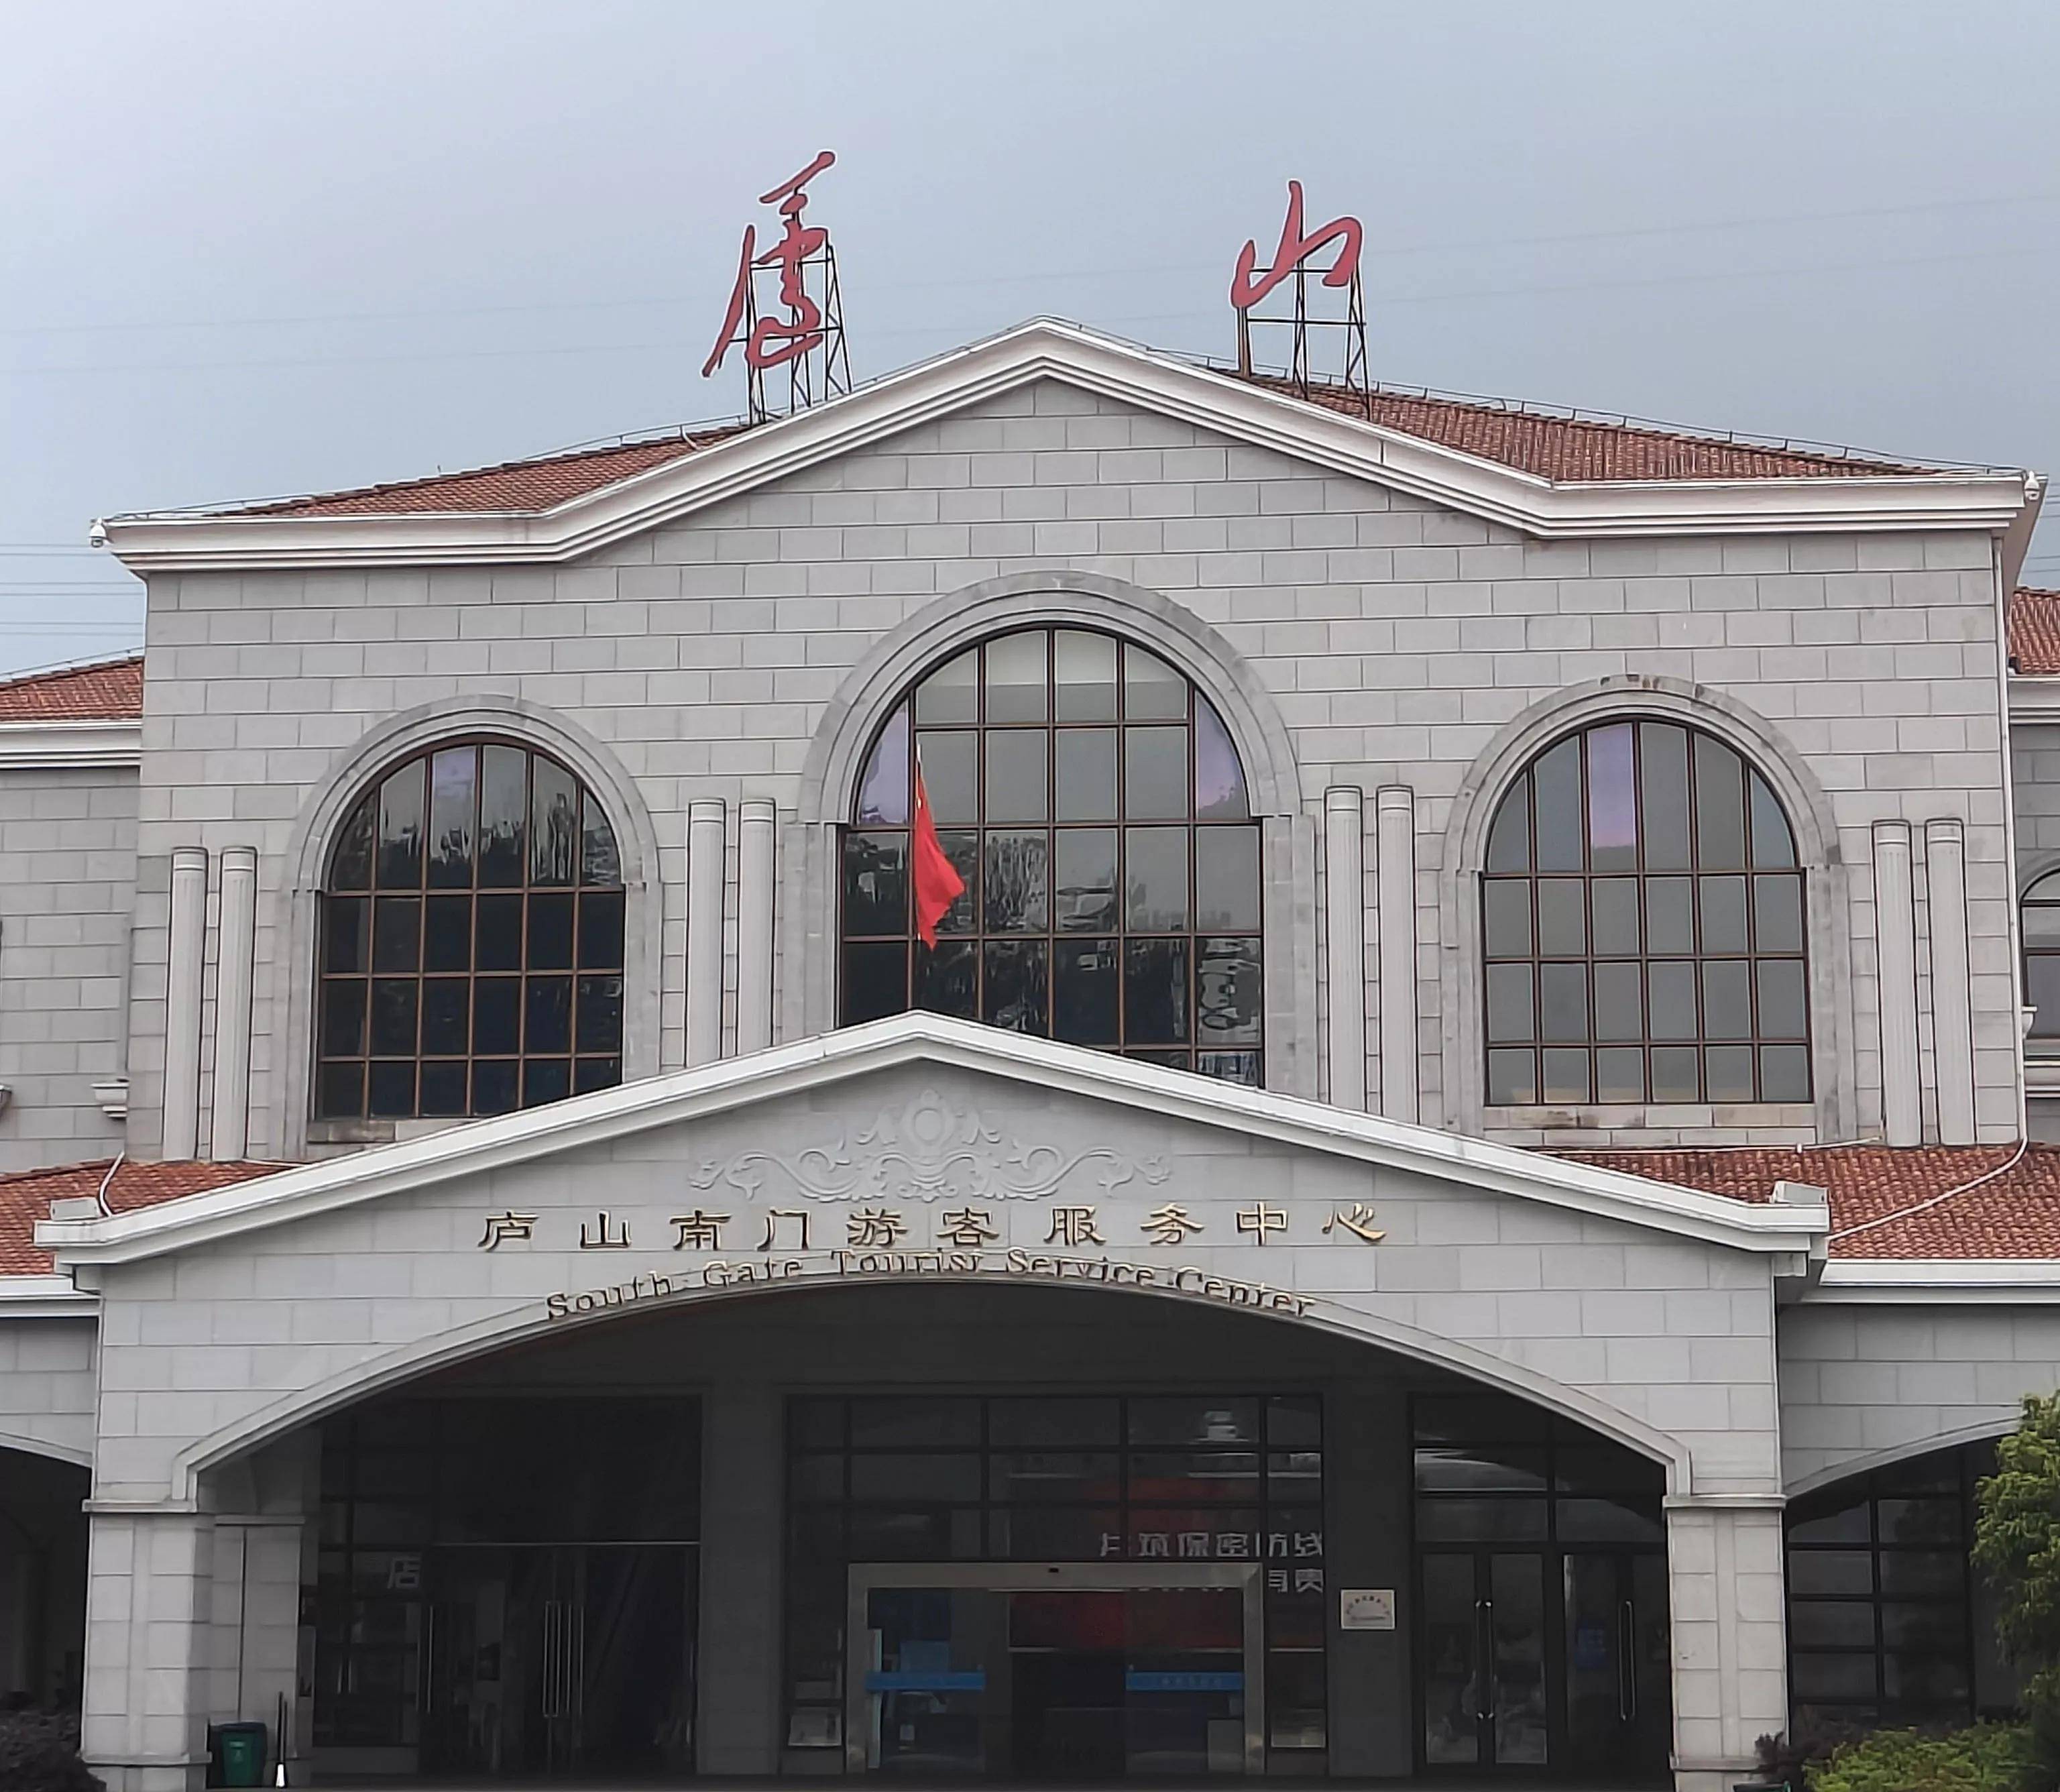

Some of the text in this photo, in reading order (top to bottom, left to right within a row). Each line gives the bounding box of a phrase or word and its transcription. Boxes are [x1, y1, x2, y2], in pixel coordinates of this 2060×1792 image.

[477, 1202, 1387, 1251] 庐山南门游客服务中心
[545, 1247, 1317, 1321] South Gate Tourist Service Center
